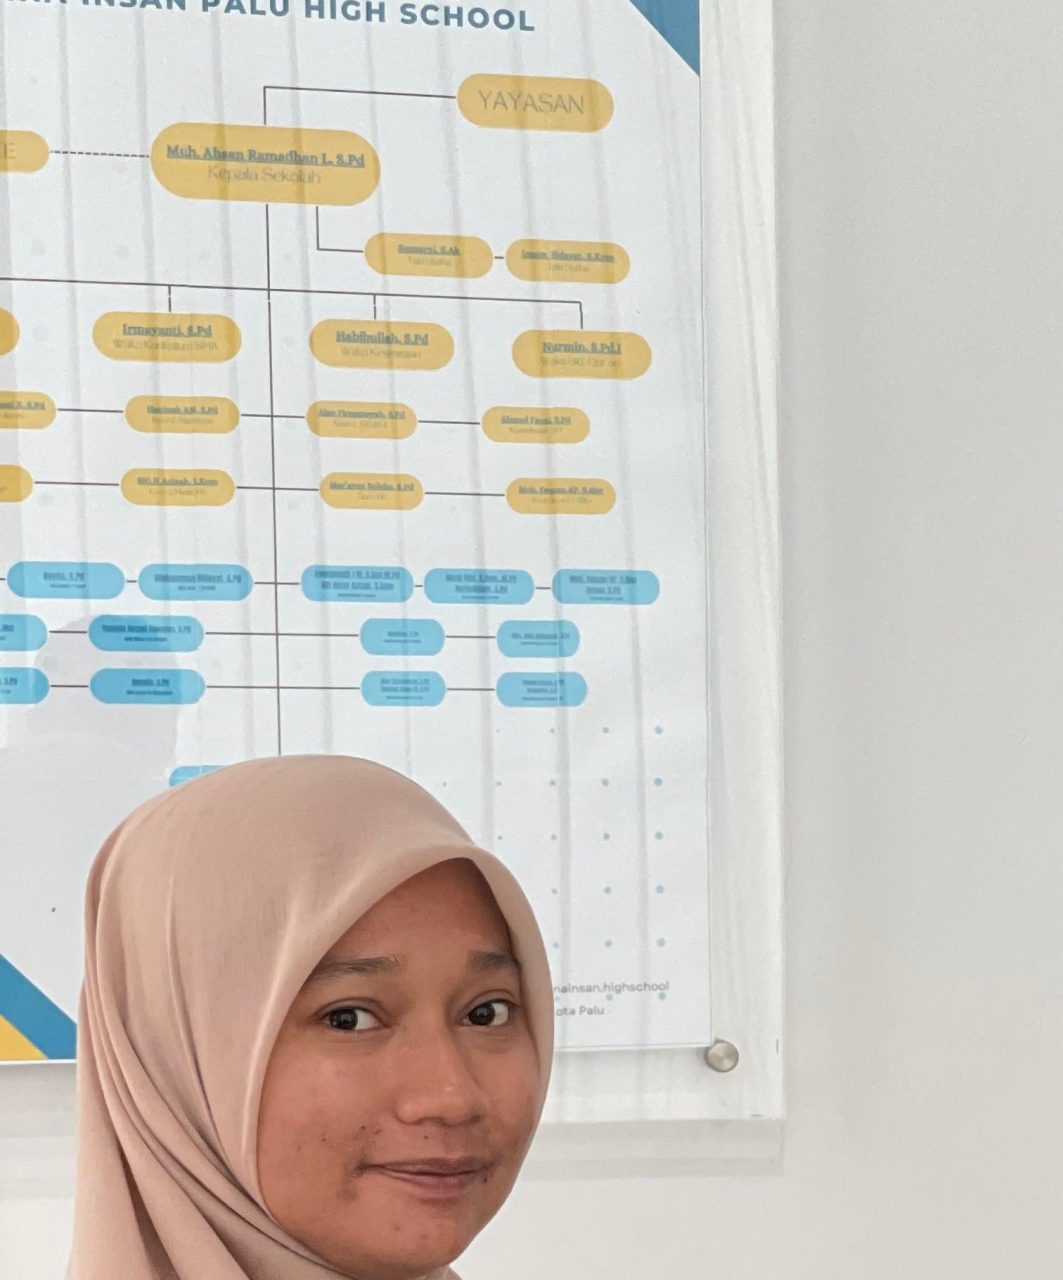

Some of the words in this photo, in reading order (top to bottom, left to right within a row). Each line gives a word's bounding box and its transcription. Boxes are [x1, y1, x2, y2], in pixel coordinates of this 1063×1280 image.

[305, 0, 386, 22] HIGH
[400, 3, 535, 31] SCHOOL
[477, 89, 585, 115] YAYASAN
[208, 165, 258, 183] Kepala
[262, 168, 321, 184] Sekolah
[554, 980, 669, 994] nainsan.highschool
[556, 1006, 575, 1016] ota
[579, 1005, 605, 1015] Palu
